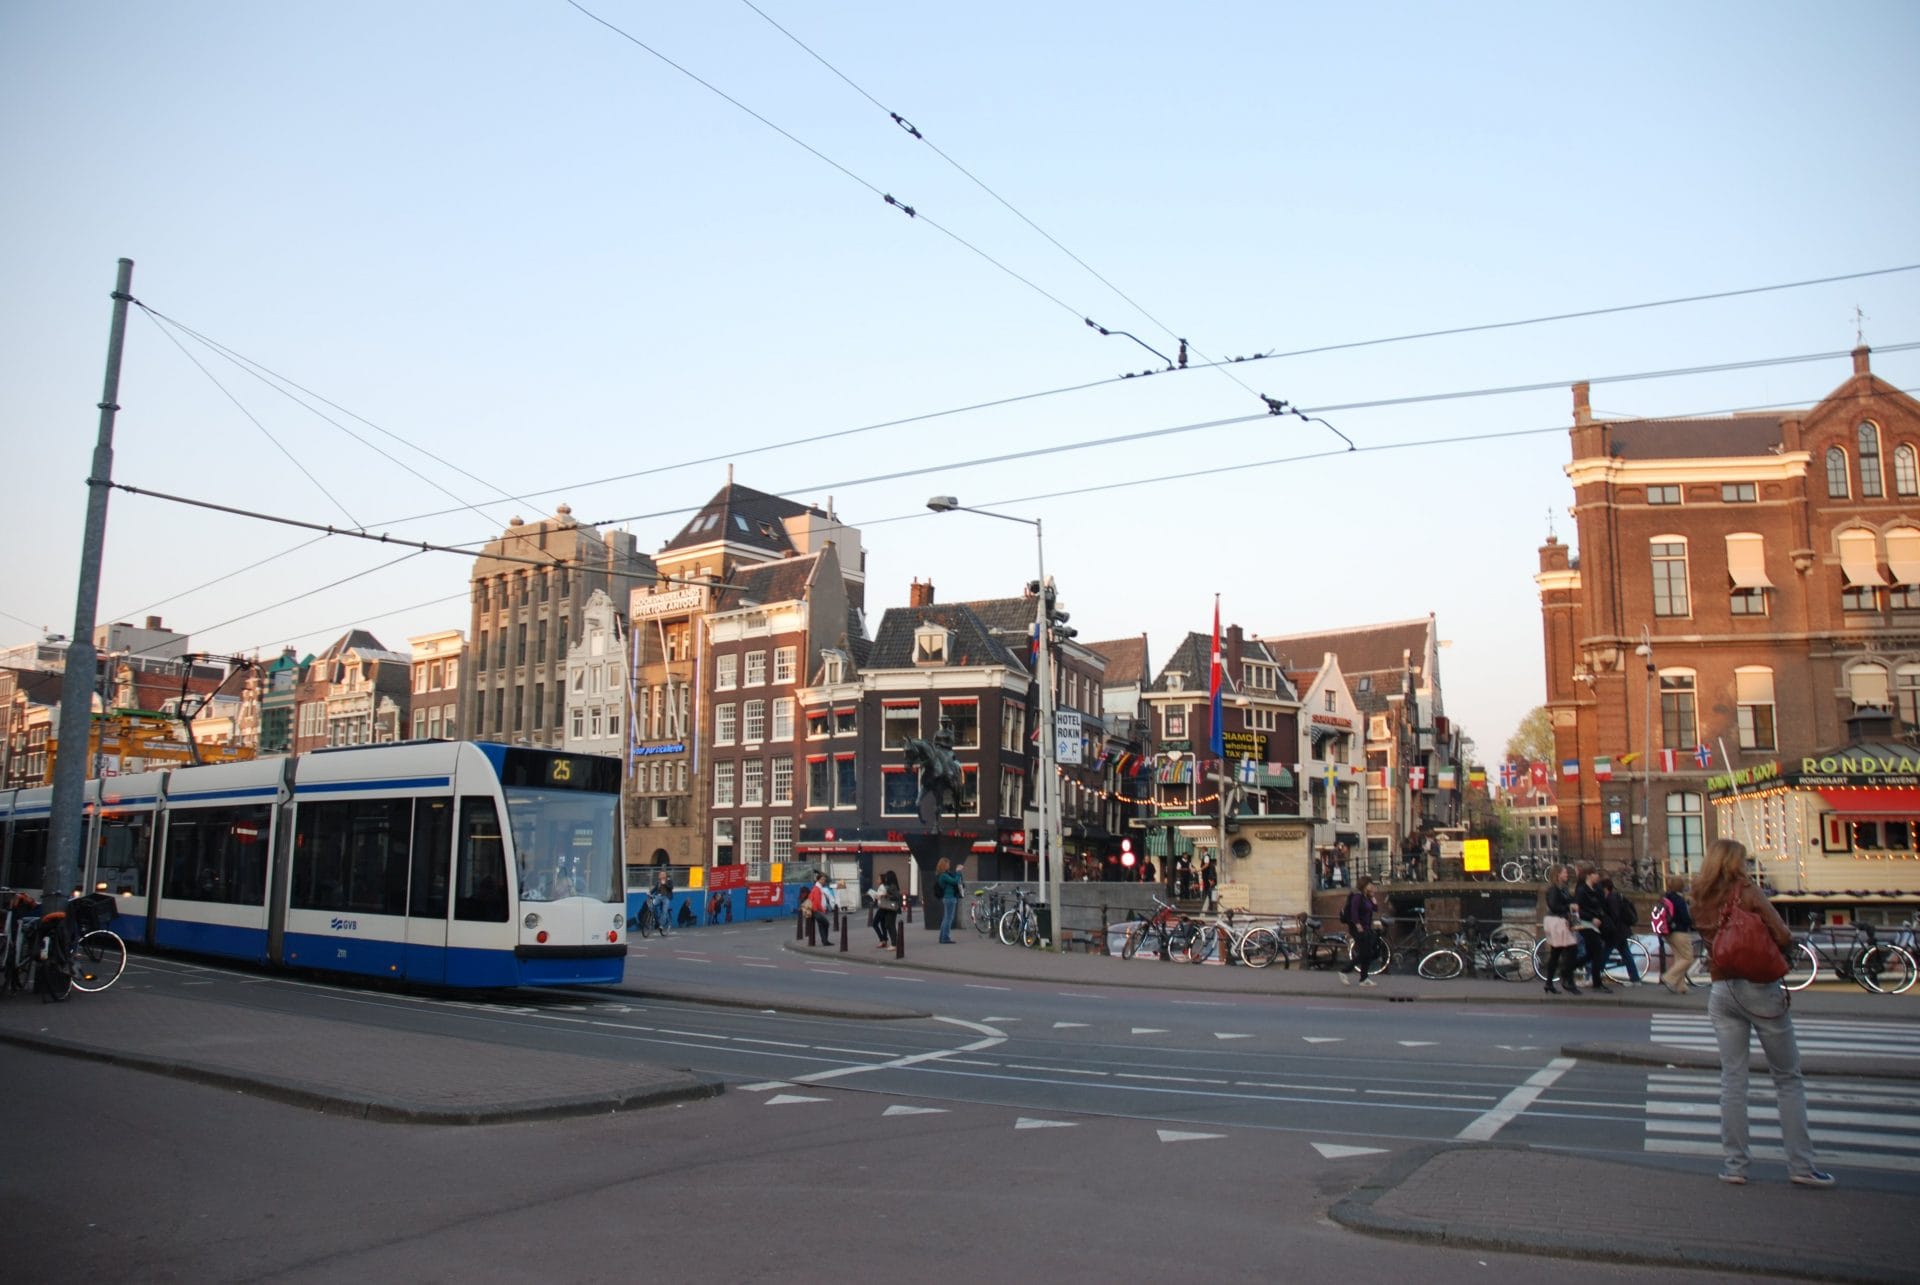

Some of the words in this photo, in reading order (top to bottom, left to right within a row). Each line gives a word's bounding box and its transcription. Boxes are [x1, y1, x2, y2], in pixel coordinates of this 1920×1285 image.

[1057, 715, 1081, 726] HOTEL
[1057, 727, 1080, 739] ROKIN
[554, 759, 571, 780] 25
[1802, 757, 1920, 774] RONDVA
[1799, 776, 1848, 785] RONDVAART
[1884, 776, 1918, 785] HAVENS
[343, 920, 357, 930] GVB
